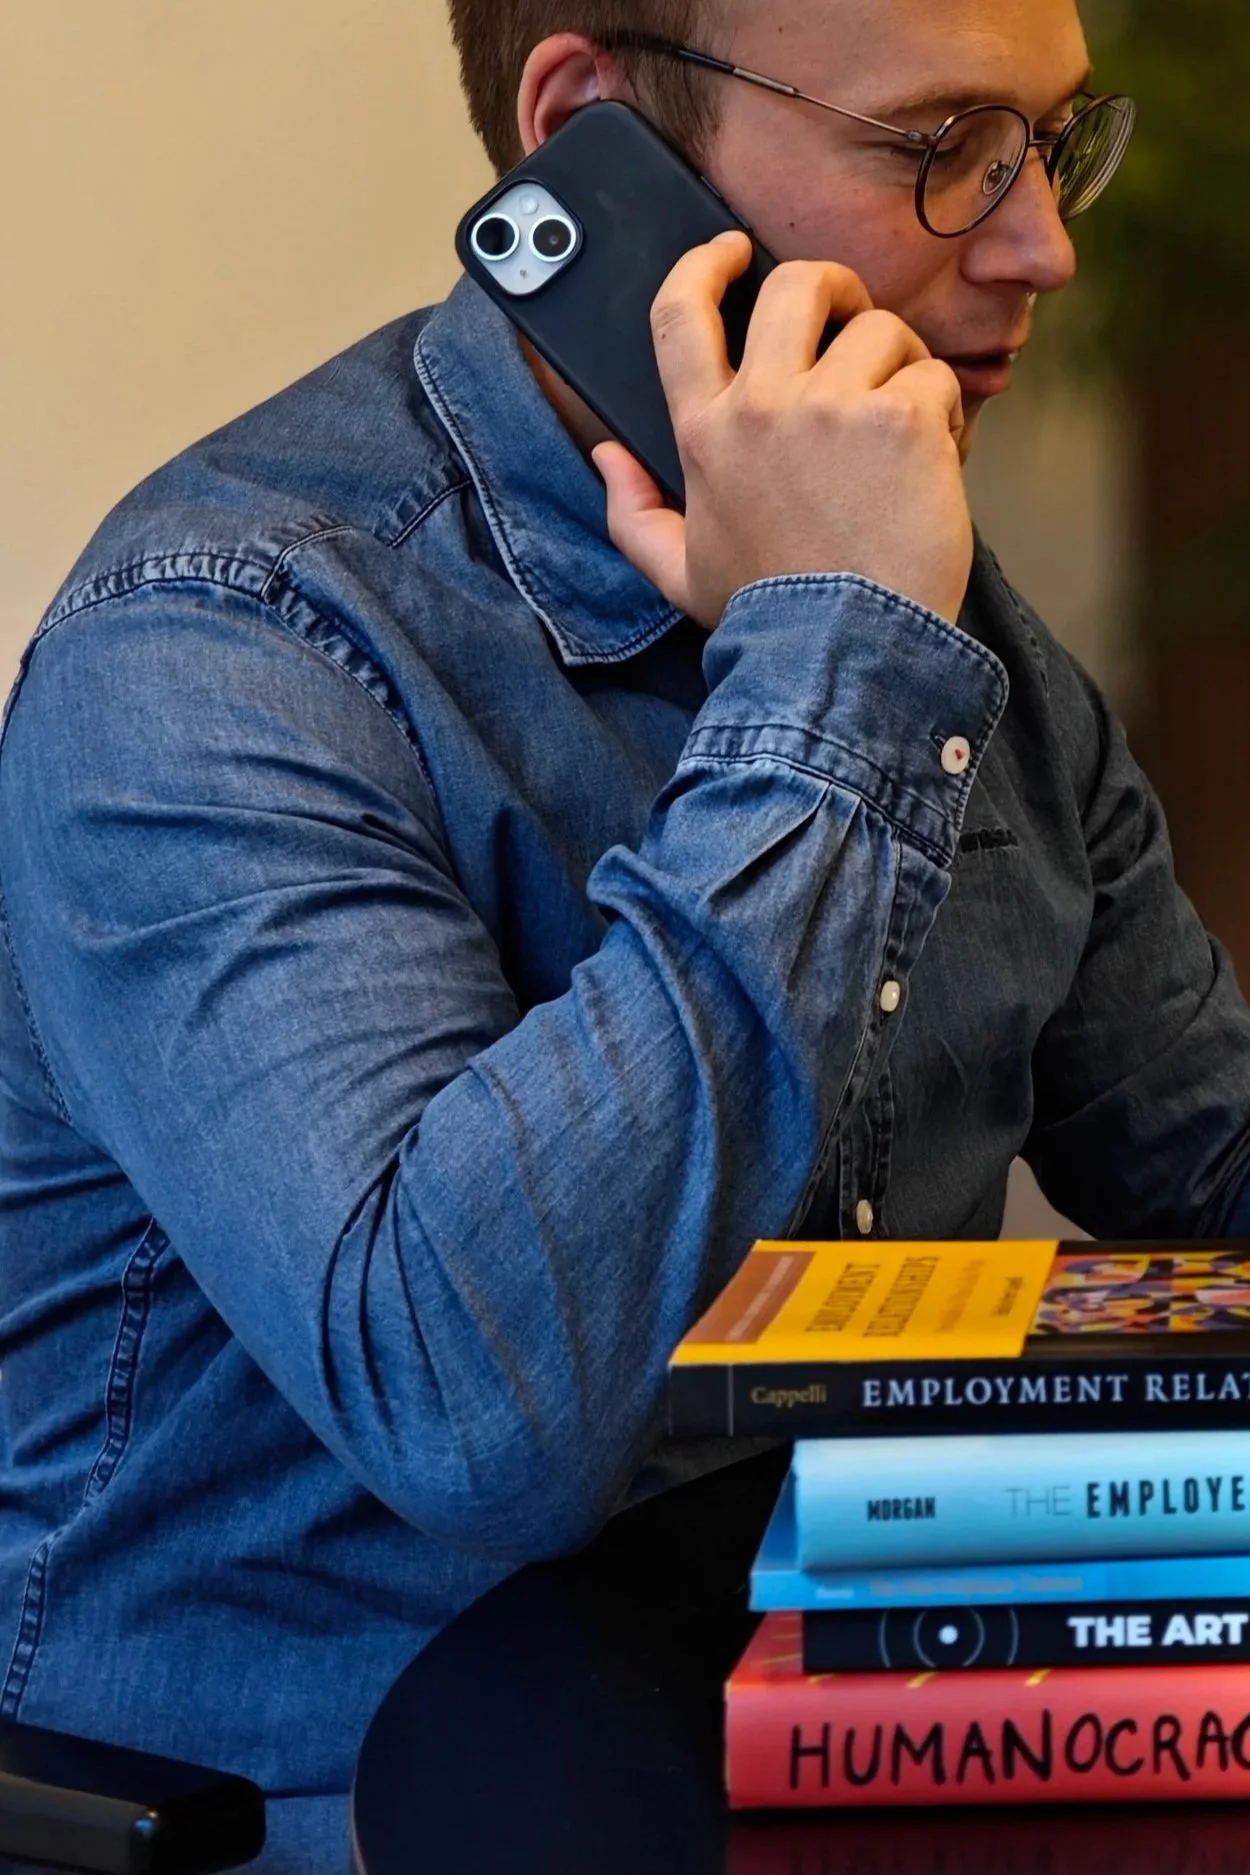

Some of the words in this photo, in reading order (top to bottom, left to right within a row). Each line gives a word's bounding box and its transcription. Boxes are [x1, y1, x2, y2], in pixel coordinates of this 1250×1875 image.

[750, 1382, 828, 1410] Cappelli
[862, 1374, 1130, 1408] EMPLOYMENT
[866, 1495, 937, 1523] MORGAN
[1003, 1485, 1074, 1518] THE
[1068, 1615, 1153, 1649] THE
[1161, 1612, 1249, 1648] ART
